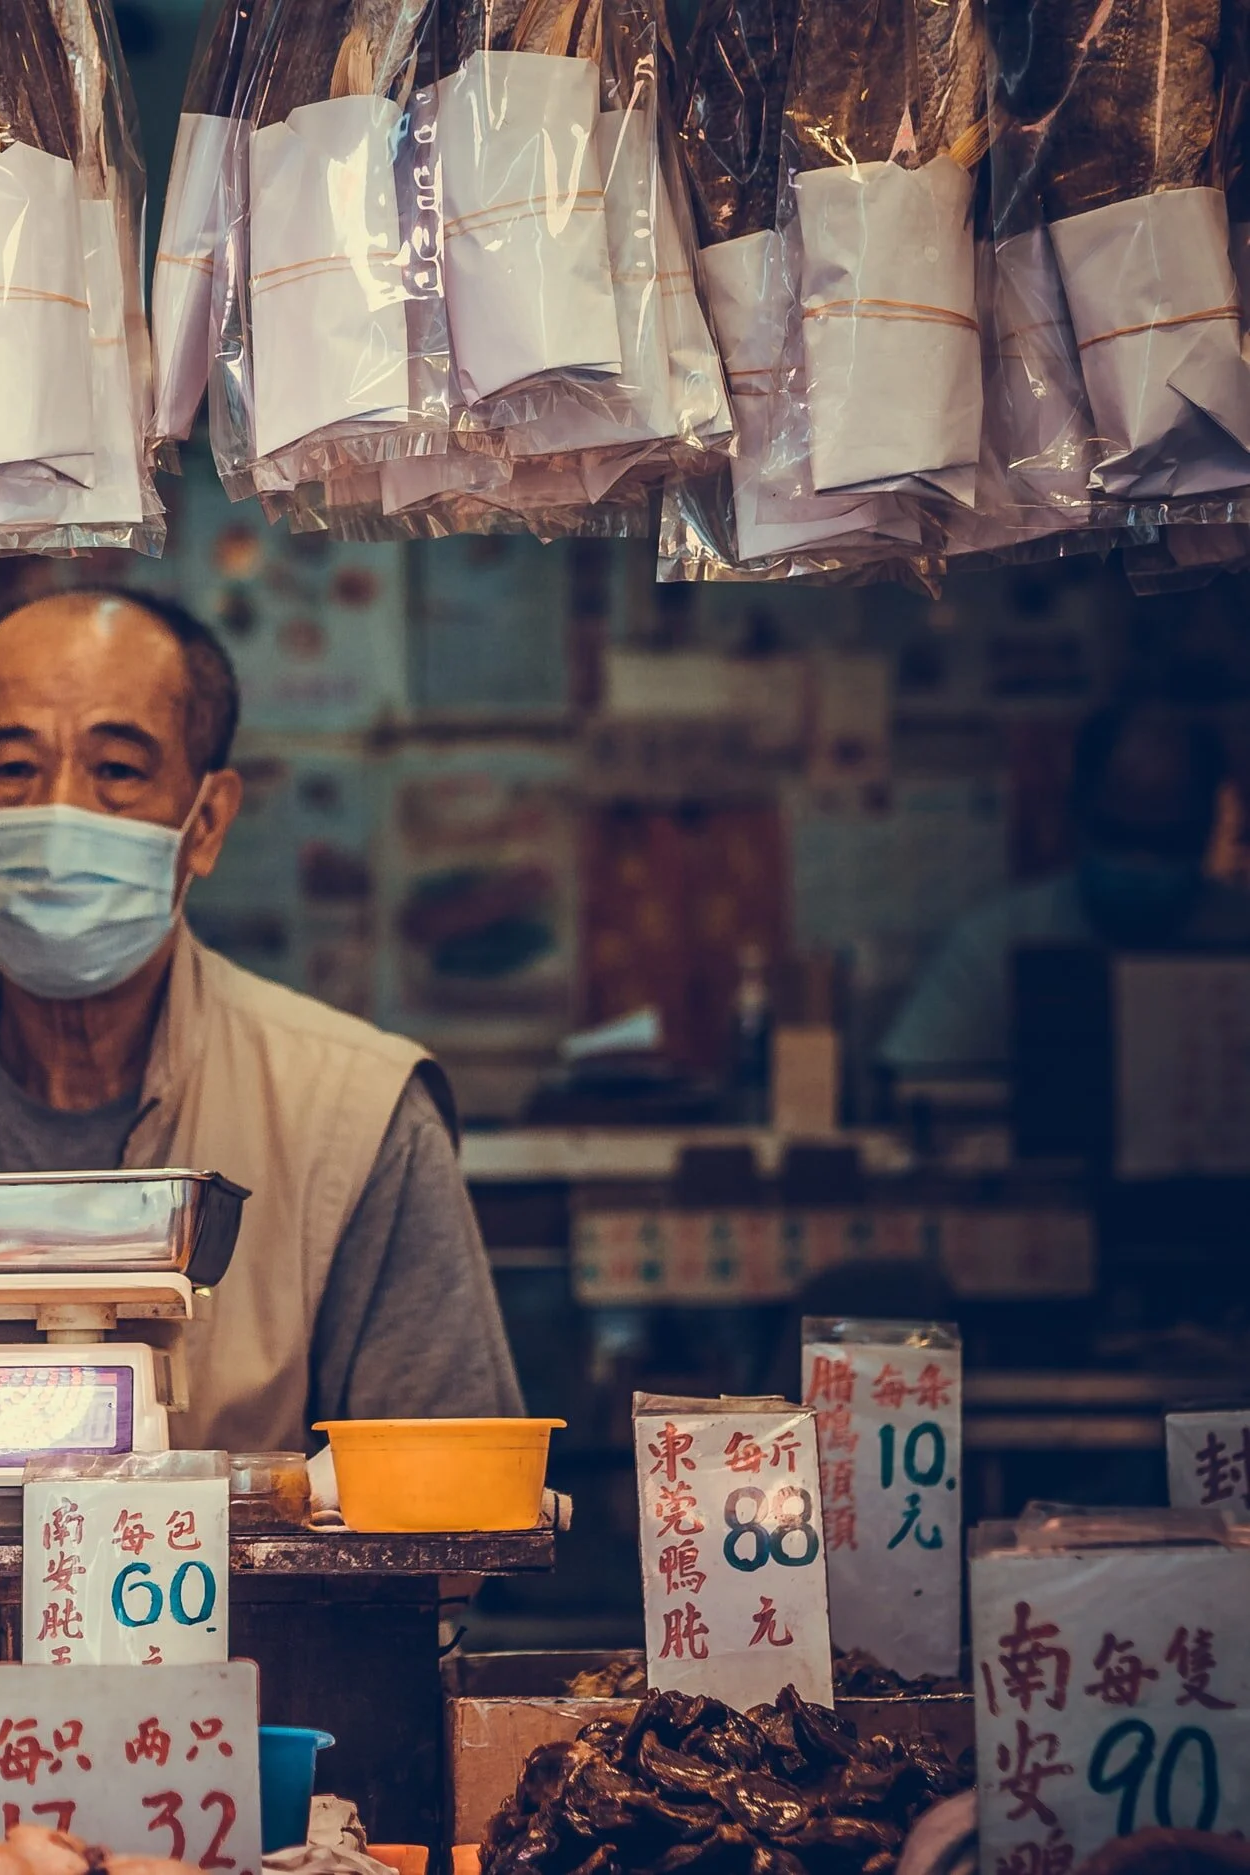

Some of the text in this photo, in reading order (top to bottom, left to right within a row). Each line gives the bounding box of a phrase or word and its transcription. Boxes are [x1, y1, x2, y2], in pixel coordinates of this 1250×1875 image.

[724, 1431, 801, 1473] 每斤
[112, 1509, 201, 1555] 每包
[648, 1421, 710, 1660] 東莞鴨肫
[723, 1486, 819, 1572] 88
[886, 1494, 943, 1549] 元
[748, 1596, 793, 1648] 元
[1084, 1625, 1237, 1710] 每隻
